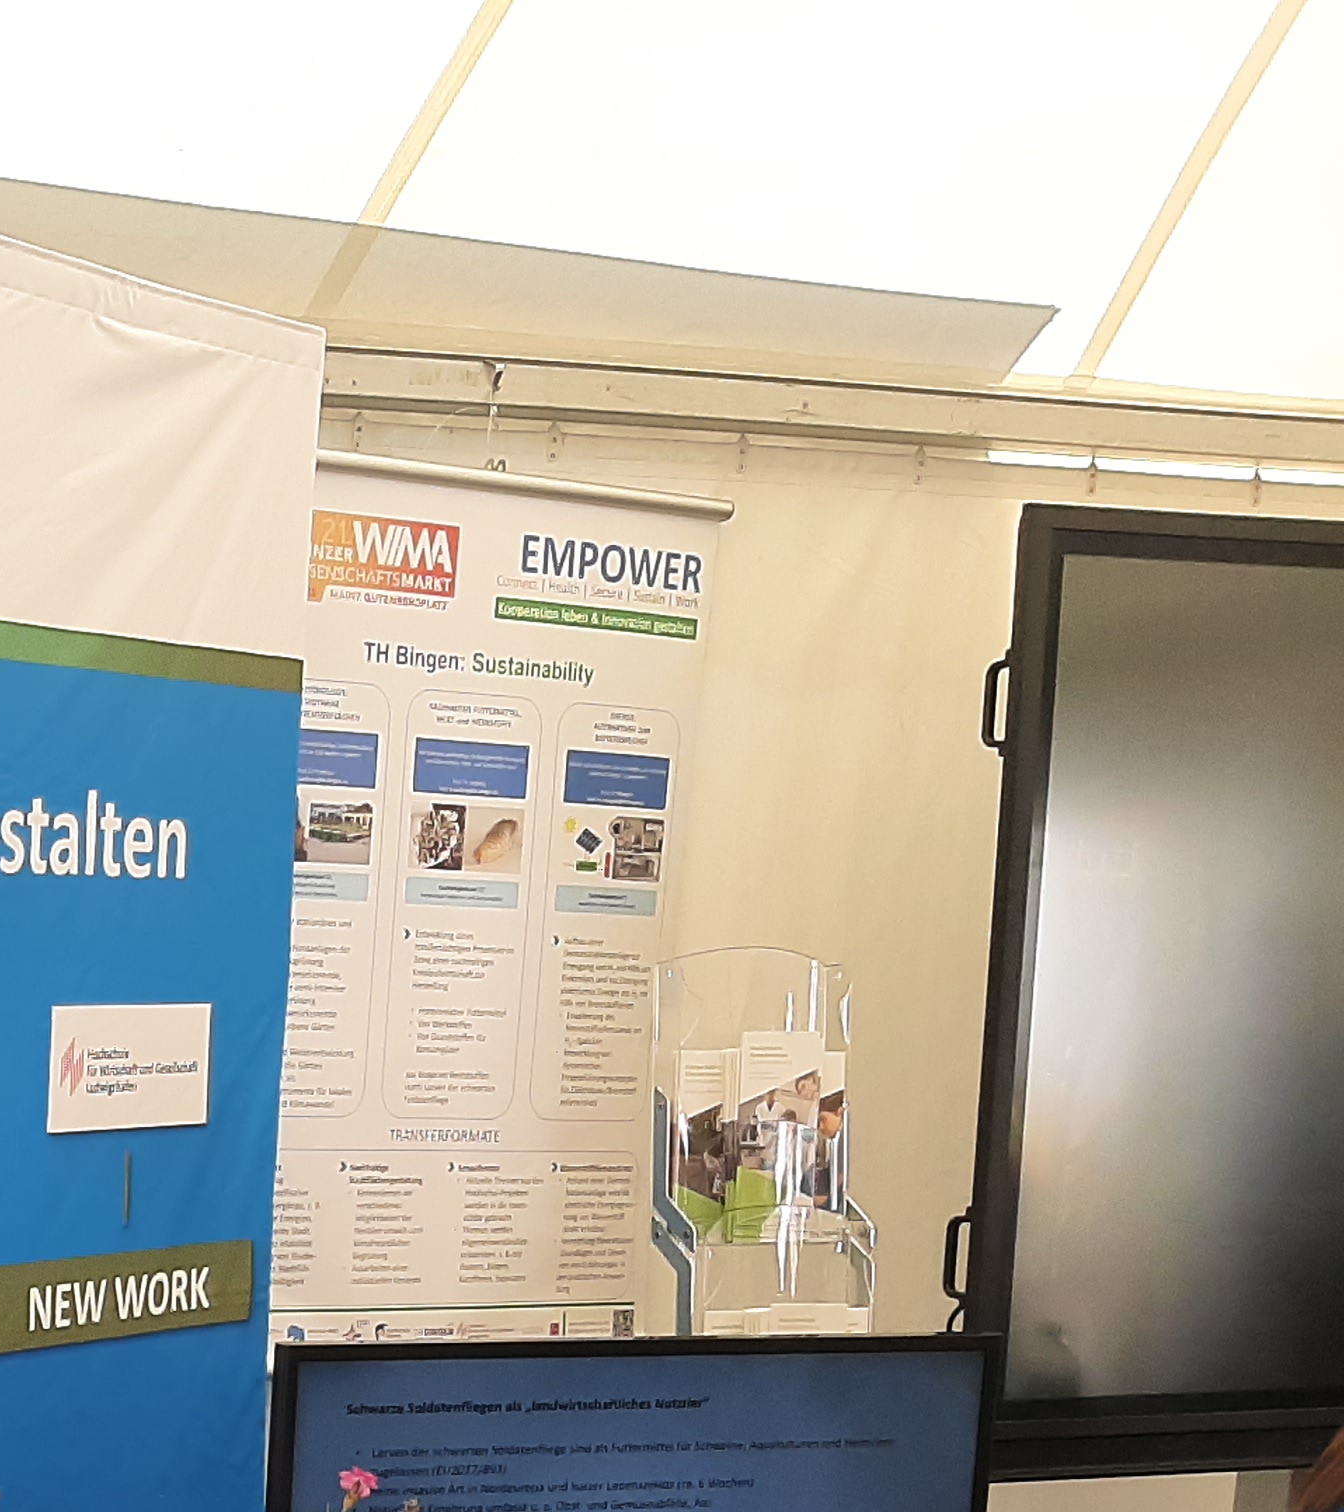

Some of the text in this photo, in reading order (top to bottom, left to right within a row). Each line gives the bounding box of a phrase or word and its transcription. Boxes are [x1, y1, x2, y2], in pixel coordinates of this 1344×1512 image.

[313, 544, 353, 563] NZER
[353, 520, 453, 573] WIMA
[521, 534, 702, 593] EMPOWER
[364, 641, 595, 688] TH Bingen: Sustainability
[389, 1127, 502, 1145] TRANSFERFORMATE
[27, 1265, 212, 1333] NEW WORK
